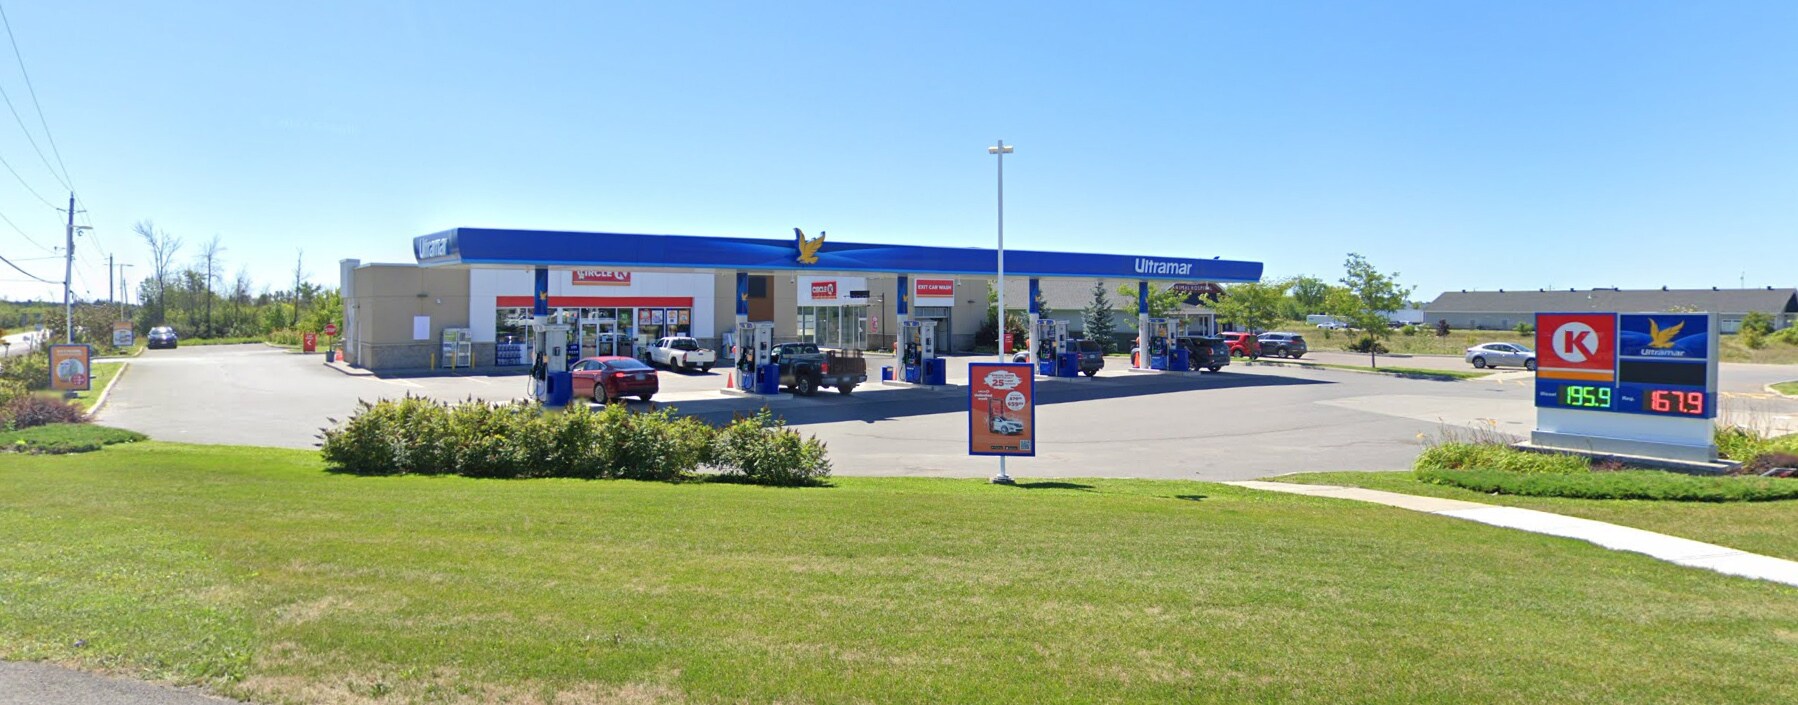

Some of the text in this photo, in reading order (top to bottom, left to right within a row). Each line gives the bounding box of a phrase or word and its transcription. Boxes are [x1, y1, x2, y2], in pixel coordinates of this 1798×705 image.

[1135, 258, 1192, 275] Ultramar
[827, 283, 834, 295] K
[1562, 328, 1596, 361] K
[1640, 348, 1686, 357] Ultramar
[992, 379, 1004, 387] 25
[1566, 385, 1611, 408] 195.9
[1651, 390, 1703, 414] 167.9
